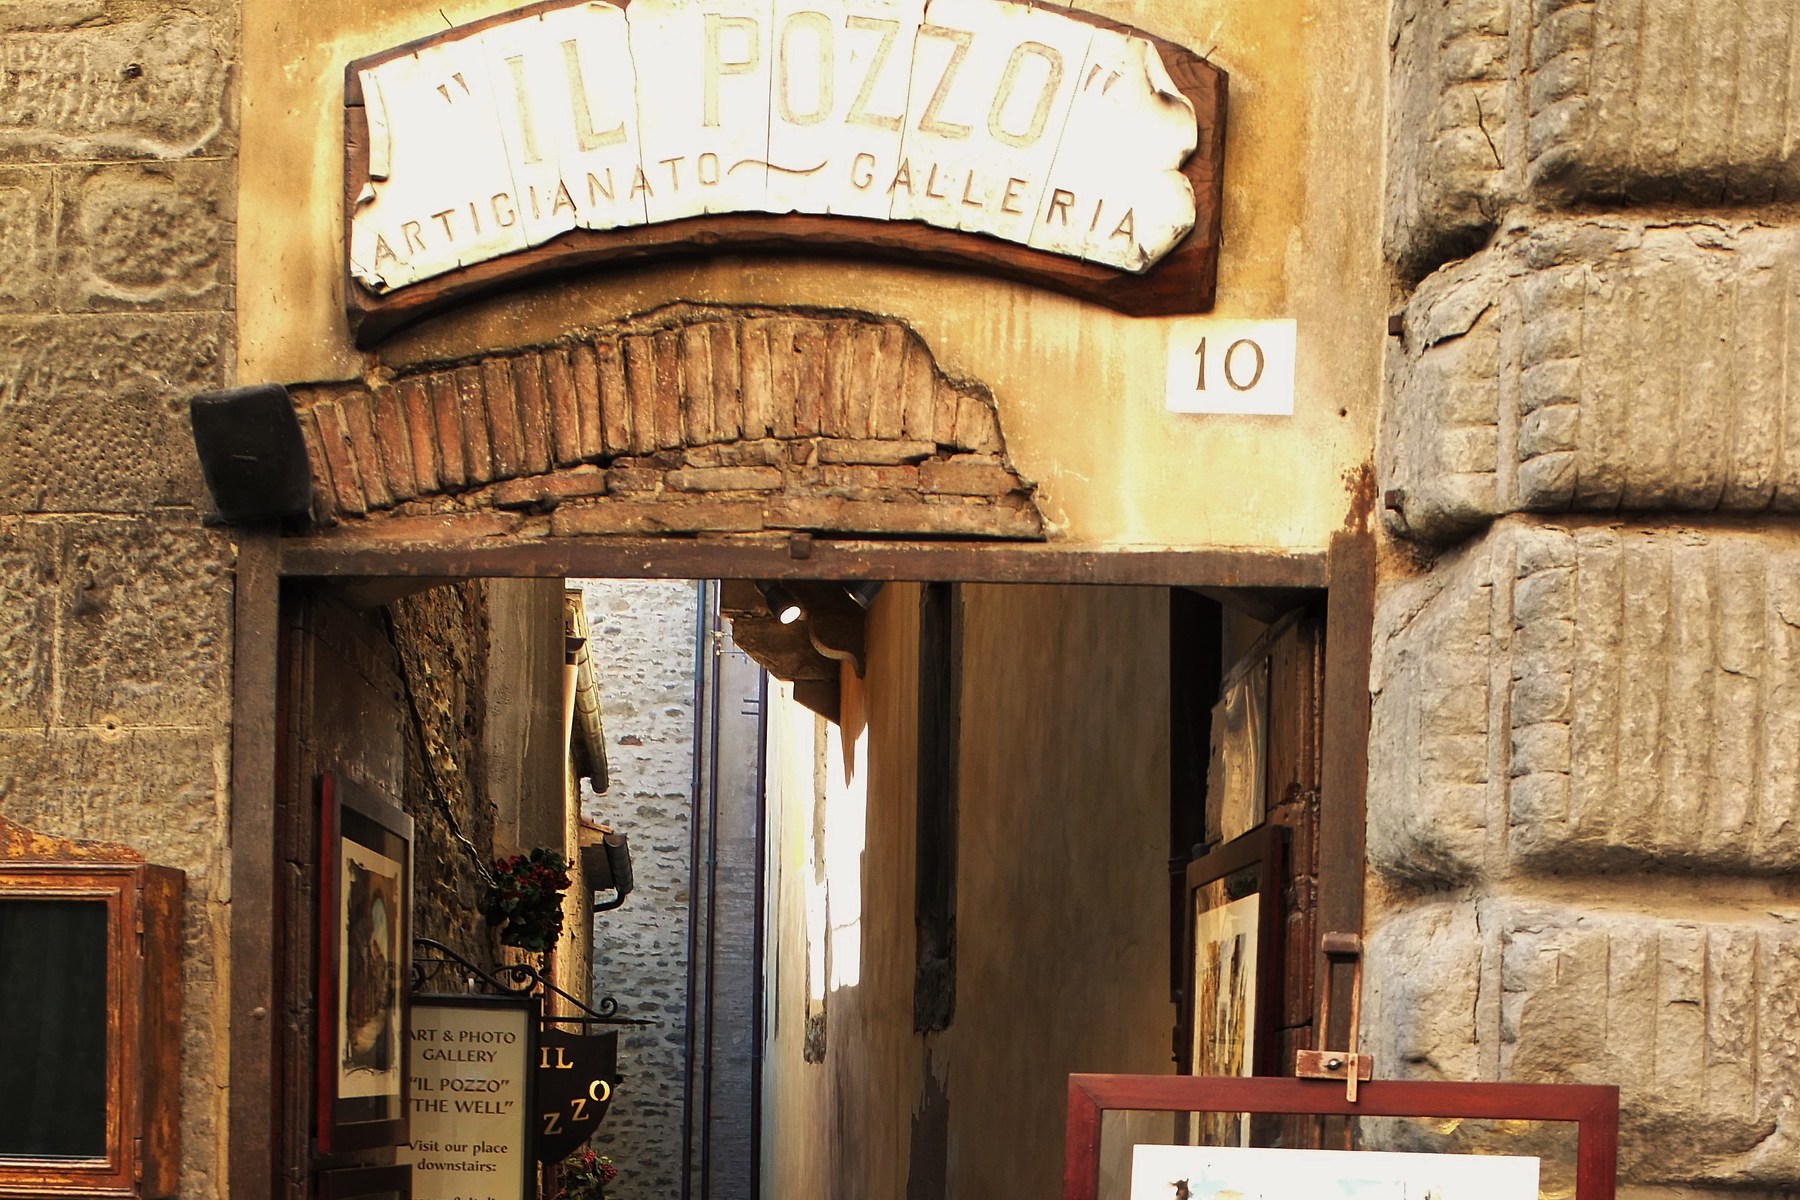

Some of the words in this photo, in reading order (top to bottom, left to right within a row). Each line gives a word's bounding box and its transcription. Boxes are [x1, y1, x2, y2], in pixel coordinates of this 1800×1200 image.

[373, 152, 720, 270] ARTIGIANATO
[850, 152, 1136, 256] GALLERIA
[1194, 335, 1265, 391] 10
[443, 1030, 454, 1042] &
[459, 1030, 516, 1044] PHOTO
[422, 1048, 498, 1063] GALLERY
[540, 1047, 573, 1069] IL
[408, 1139, 440, 1152] Visit
[444, 1144, 468, 1153] our
[472, 1141, 508, 1156] place
[417, 1158, 497, 1172] downstairs:
